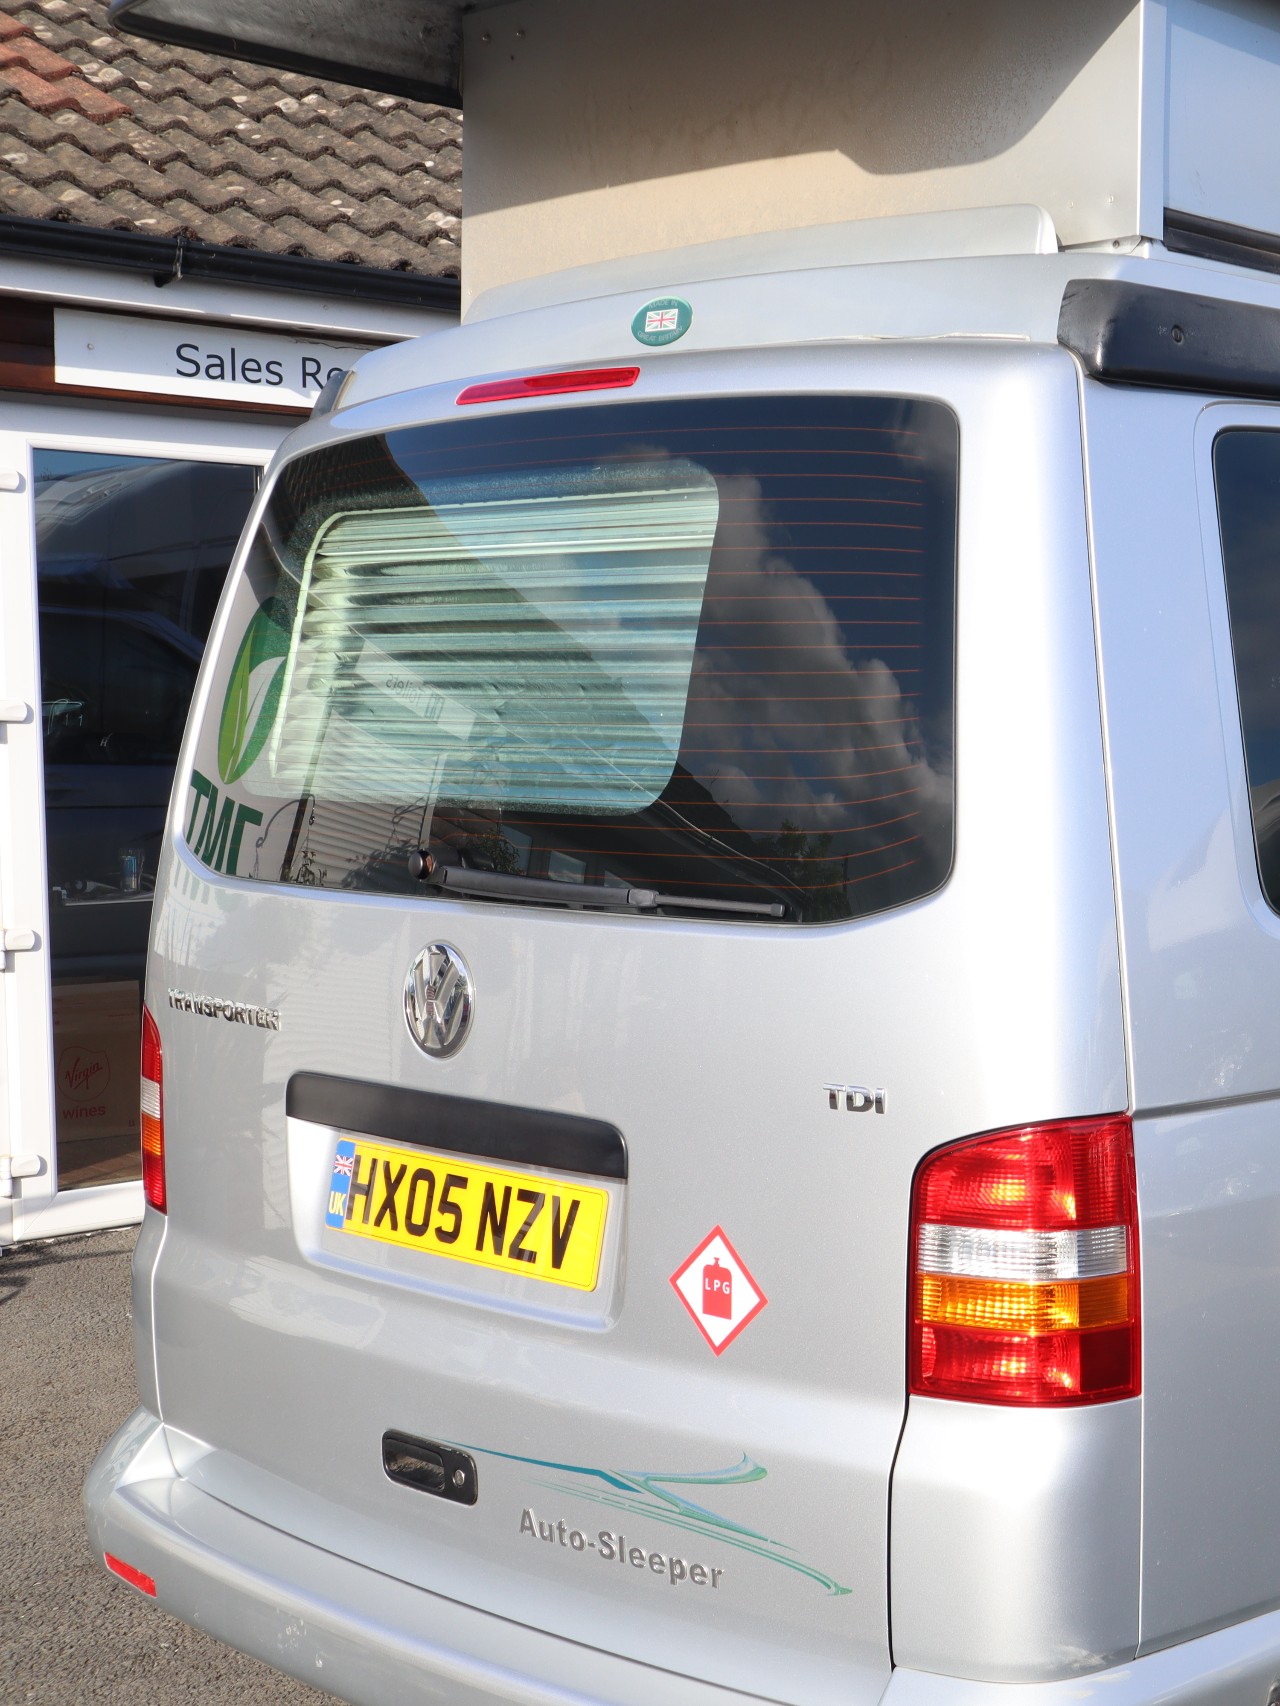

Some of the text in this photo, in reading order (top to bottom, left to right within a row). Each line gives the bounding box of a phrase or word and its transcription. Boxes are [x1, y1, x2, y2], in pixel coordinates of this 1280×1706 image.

[649, 299, 669, 309] MADE
[637, 330, 657, 342] GREAT
[176, 343, 284, 386] Sales
[168, 987, 282, 1032] TRANSPORTER
[65, 1057, 103, 1090] Virgin
[62, 1103, 106, 1120] wines
[822, 1082, 887, 1115] TDI
[329, 1190, 347, 1217] UK
[346, 1154, 581, 1270] HX05 NZV
[704, 1277, 731, 1295] LPG
[518, 1507, 725, 1589] Auto-Sleeper
